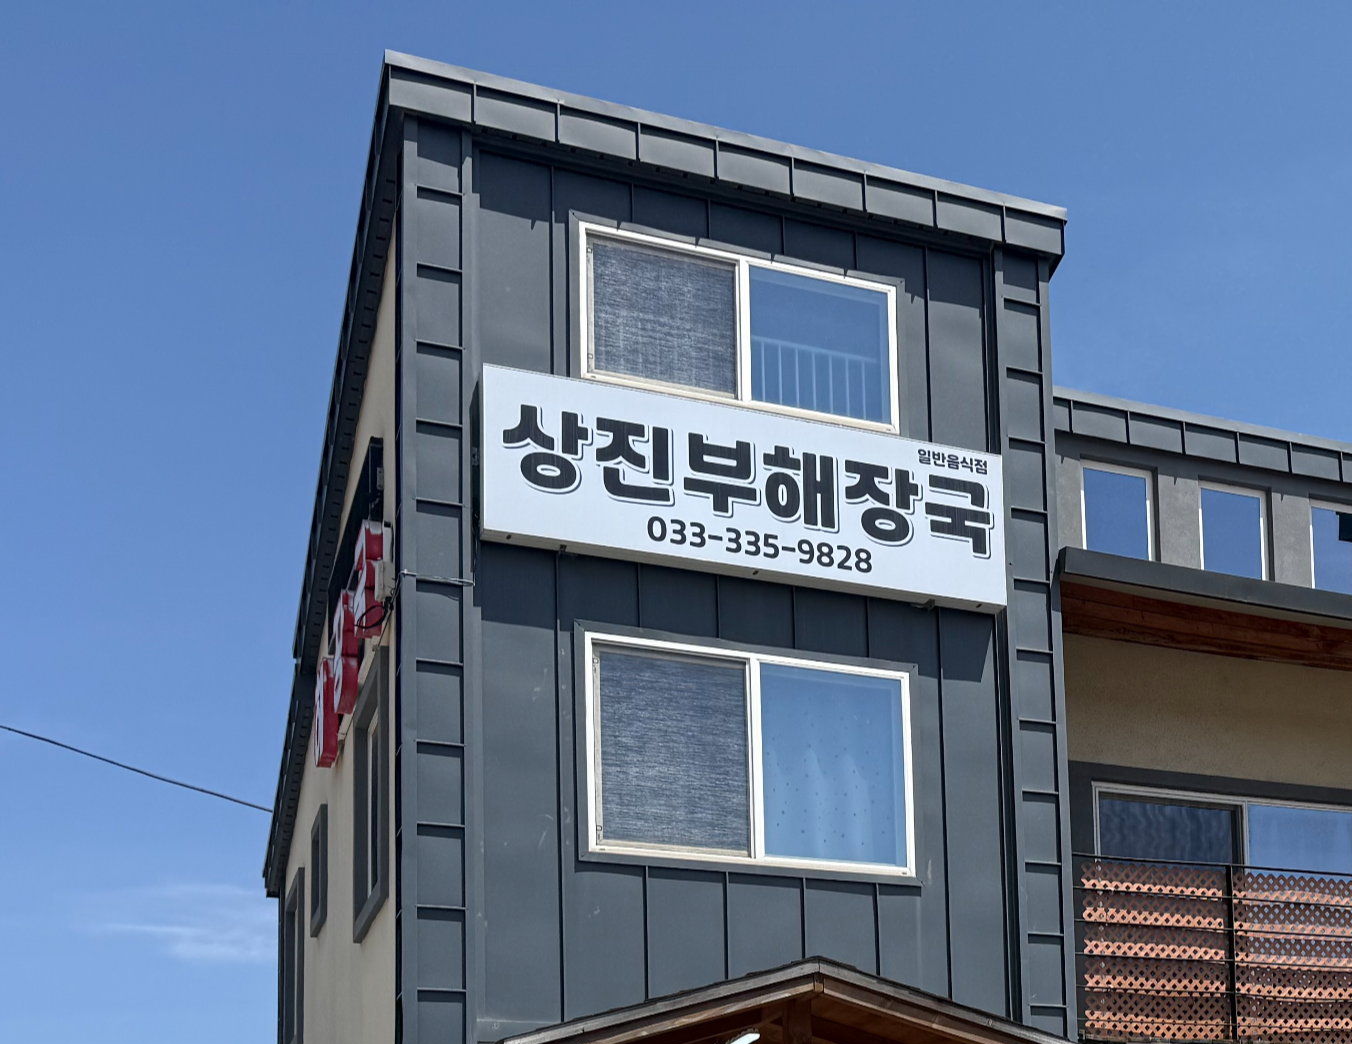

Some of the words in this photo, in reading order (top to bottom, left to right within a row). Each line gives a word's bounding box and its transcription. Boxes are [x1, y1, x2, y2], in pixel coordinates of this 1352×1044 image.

[502, 404, 992, 556] 상진부해장국
[917, 448, 989, 475] 일반음식점
[646, 515, 873, 573] 033-335-9828
